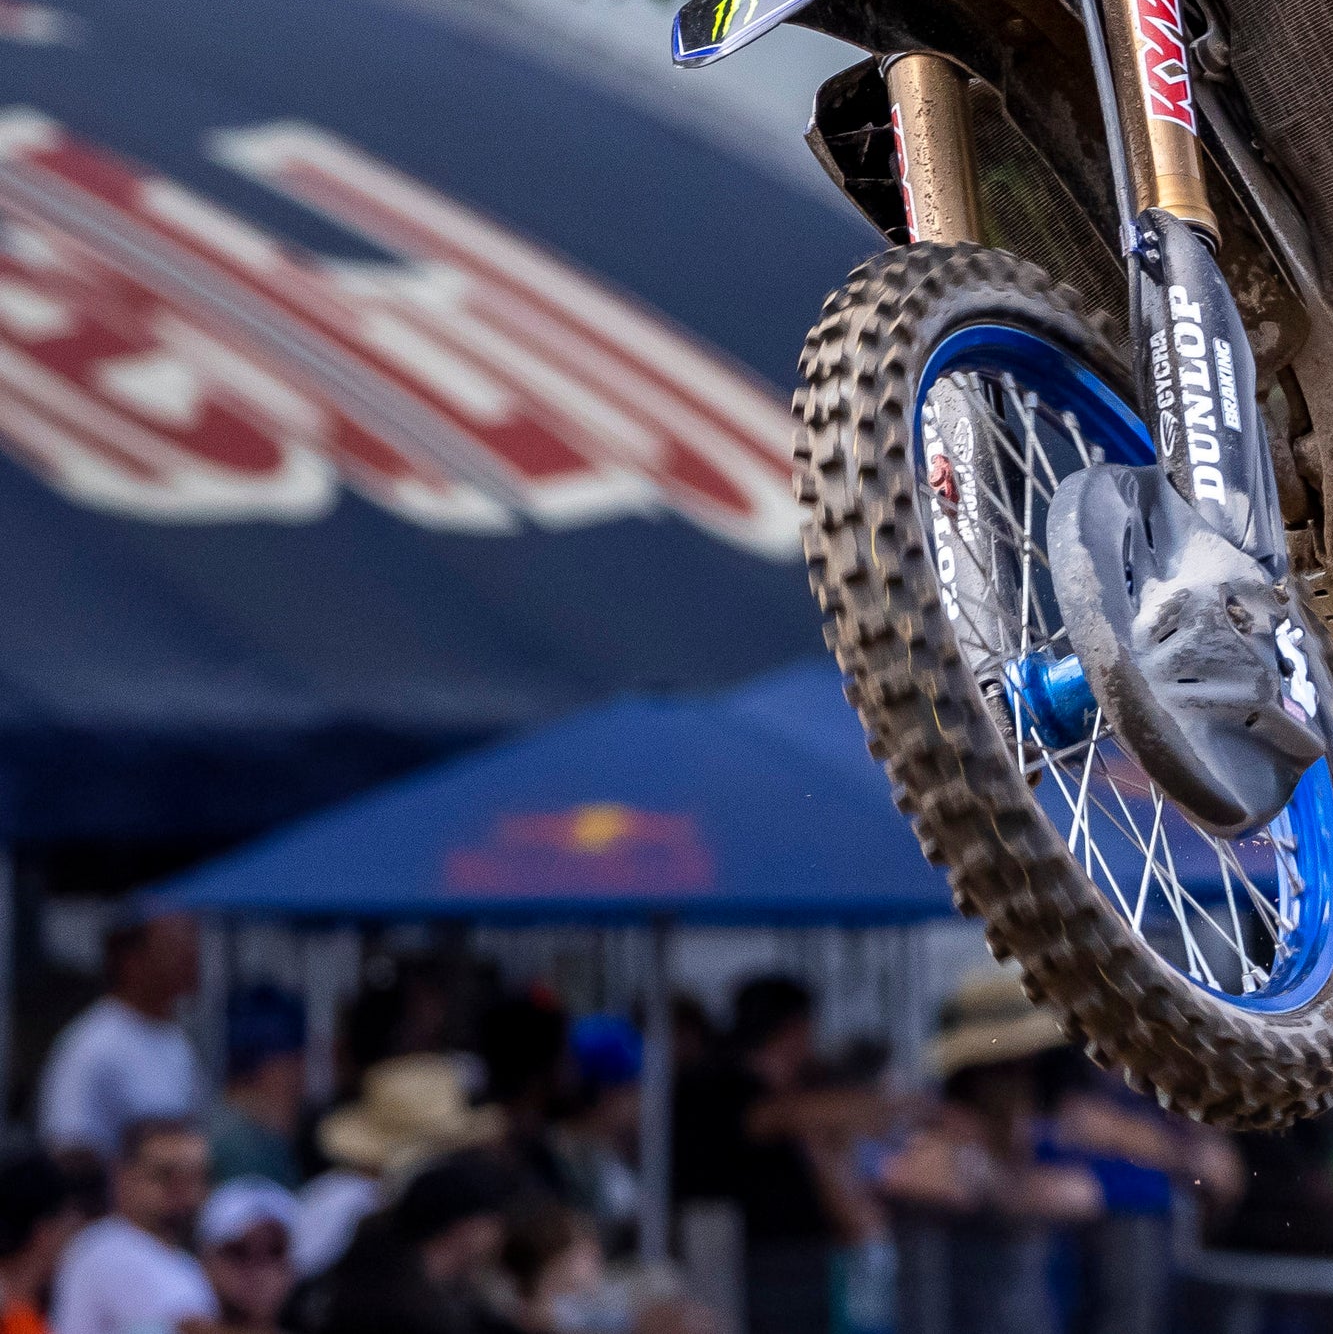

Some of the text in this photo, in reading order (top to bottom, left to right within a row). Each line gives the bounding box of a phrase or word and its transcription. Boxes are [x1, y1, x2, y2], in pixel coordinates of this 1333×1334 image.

[1149, 328, 1175, 410] CYCRA
[1168, 284, 1227, 506] DUNLOP
[1213, 337, 1241, 431] BRAKING
